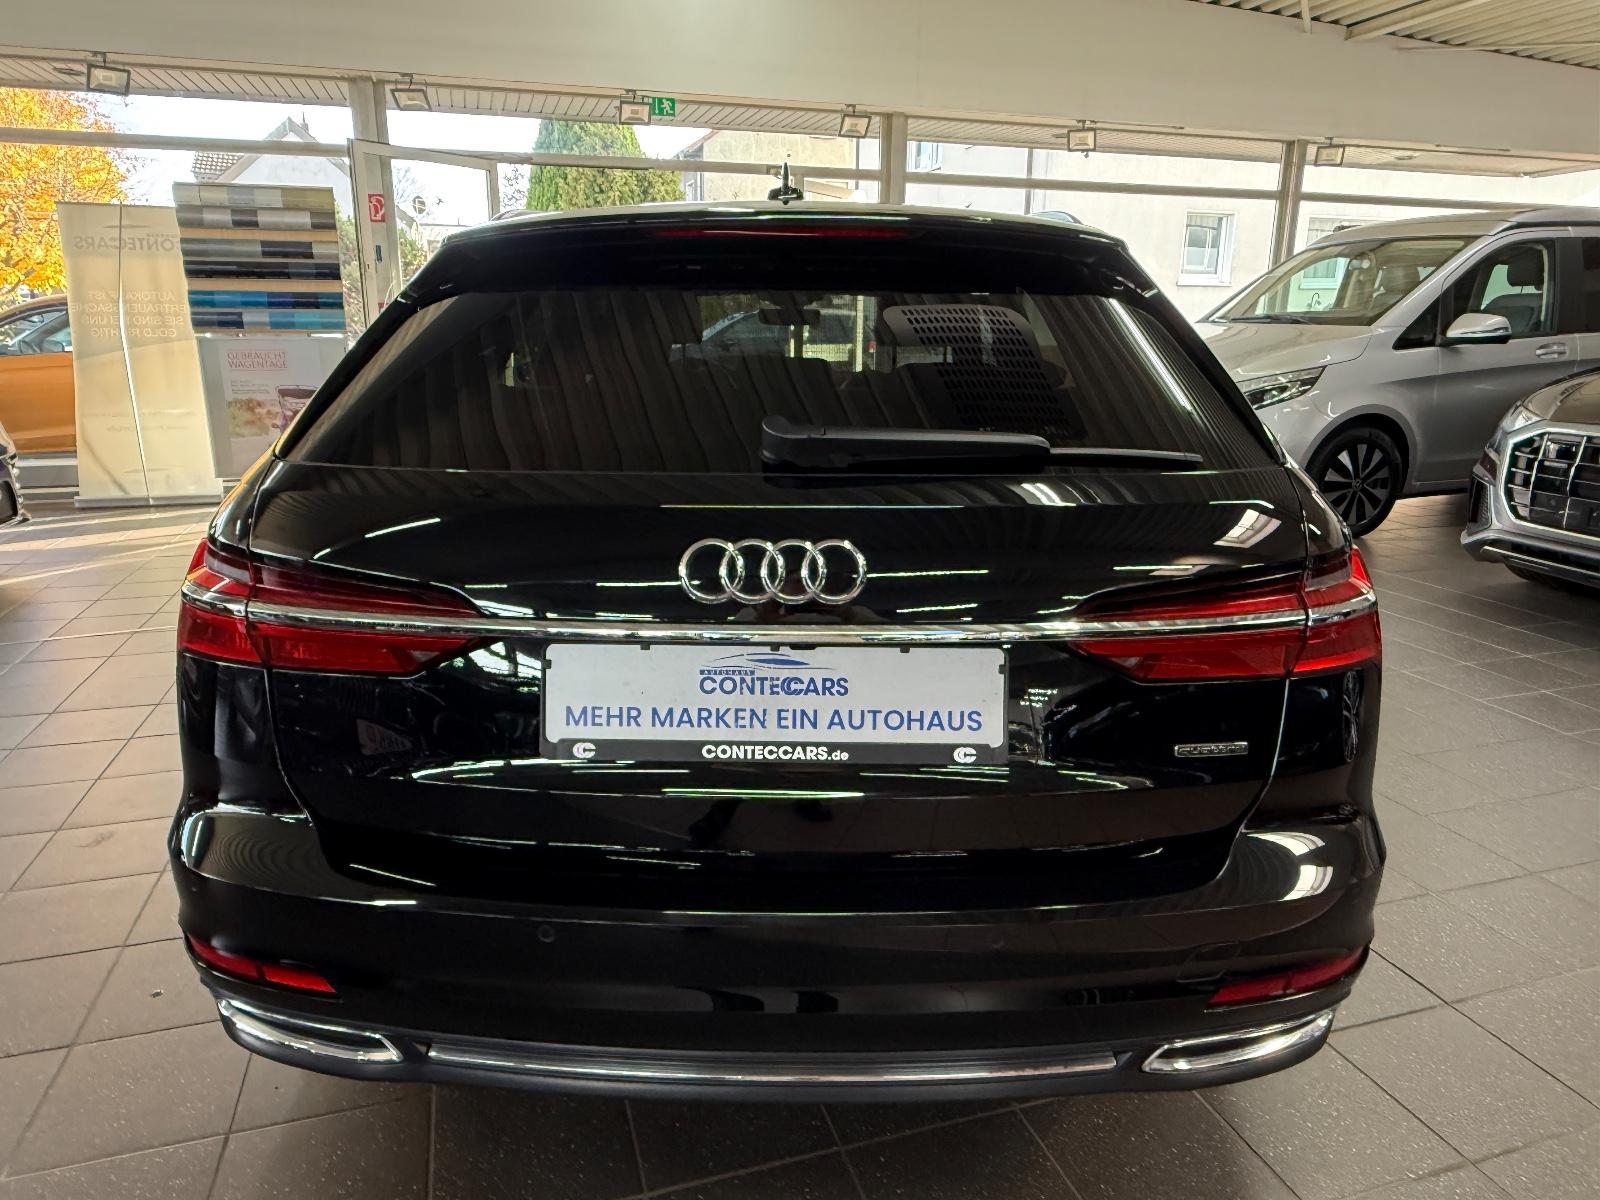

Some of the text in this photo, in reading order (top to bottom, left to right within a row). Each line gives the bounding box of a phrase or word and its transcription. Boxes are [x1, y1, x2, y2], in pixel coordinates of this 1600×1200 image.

[565, 705, 983, 732] MEHR MARKEN EIN AUTOHAUS
[701, 744, 850, 761] CONTECCARS.de
